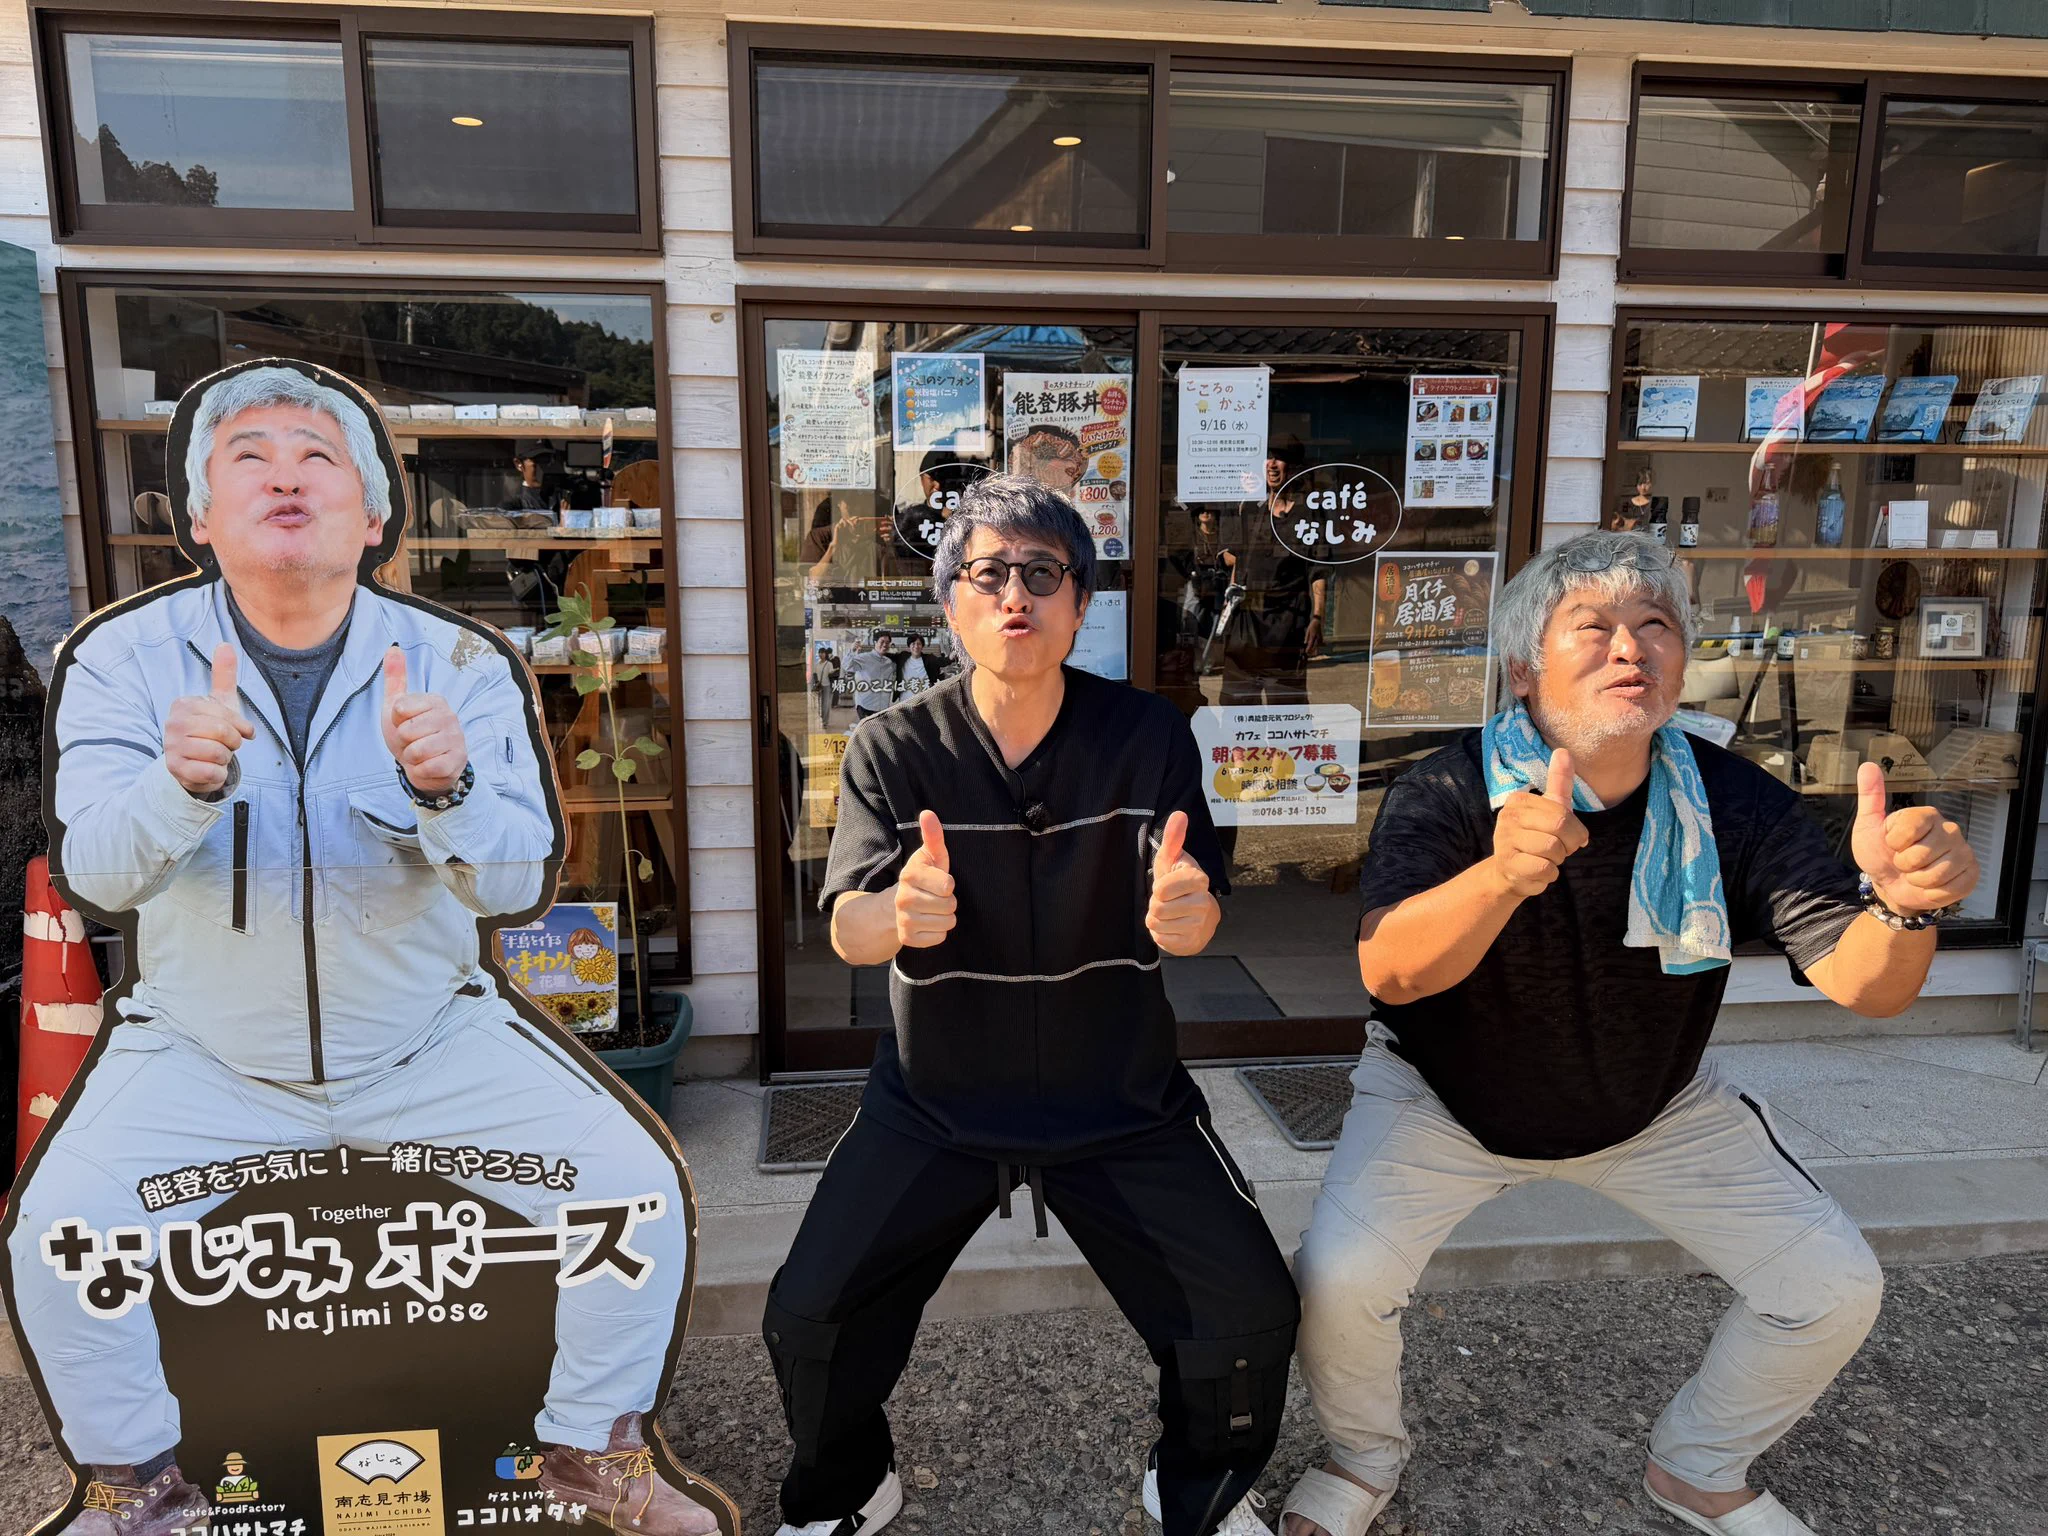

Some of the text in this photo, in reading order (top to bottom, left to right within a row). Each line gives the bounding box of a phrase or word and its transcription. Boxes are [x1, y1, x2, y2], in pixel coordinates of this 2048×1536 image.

[904, 375, 975, 387] 今週のシフォン
[1186, 380, 1234, 397] こころの
[915, 400, 937, 408] 小松菜
[1012, 389, 1102, 416] 能登豚丼
[1219, 397, 1257, 413] かふぇ
[1081, 427, 1126, 444] しいたけフライ
[930, 491, 961, 510] ca
[1306, 482, 1367, 510] café
[1088, 526, 1118, 536] 1,200
[1294, 515, 1377, 546] なじみ
[1402, 578, 1447, 602] 月イチ
[1393, 595, 1457, 627] 居酒屋
[832, 677, 940, 694] 帰りのことは考え
[1235, 728, 1329, 741] カフェ ココハサトマチ
[1211, 744, 1337, 764] 朝食スタッフ募集
[308, 1204, 392, 1224] Together
[267, 1301, 489, 1335] Najimi Pose
[358, 1453, 402, 1468] なじみ
[335, 1490, 431, 1508] 南志見市場
[488, 1489, 556, 1502] ゲストハウス
[182, 1503, 286, 1518] Cafe&FoodFactory
[336, 1508, 431, 1519] NAJIMI ICHIBA
[457, 1501, 588, 1526] ココハオダヤ
